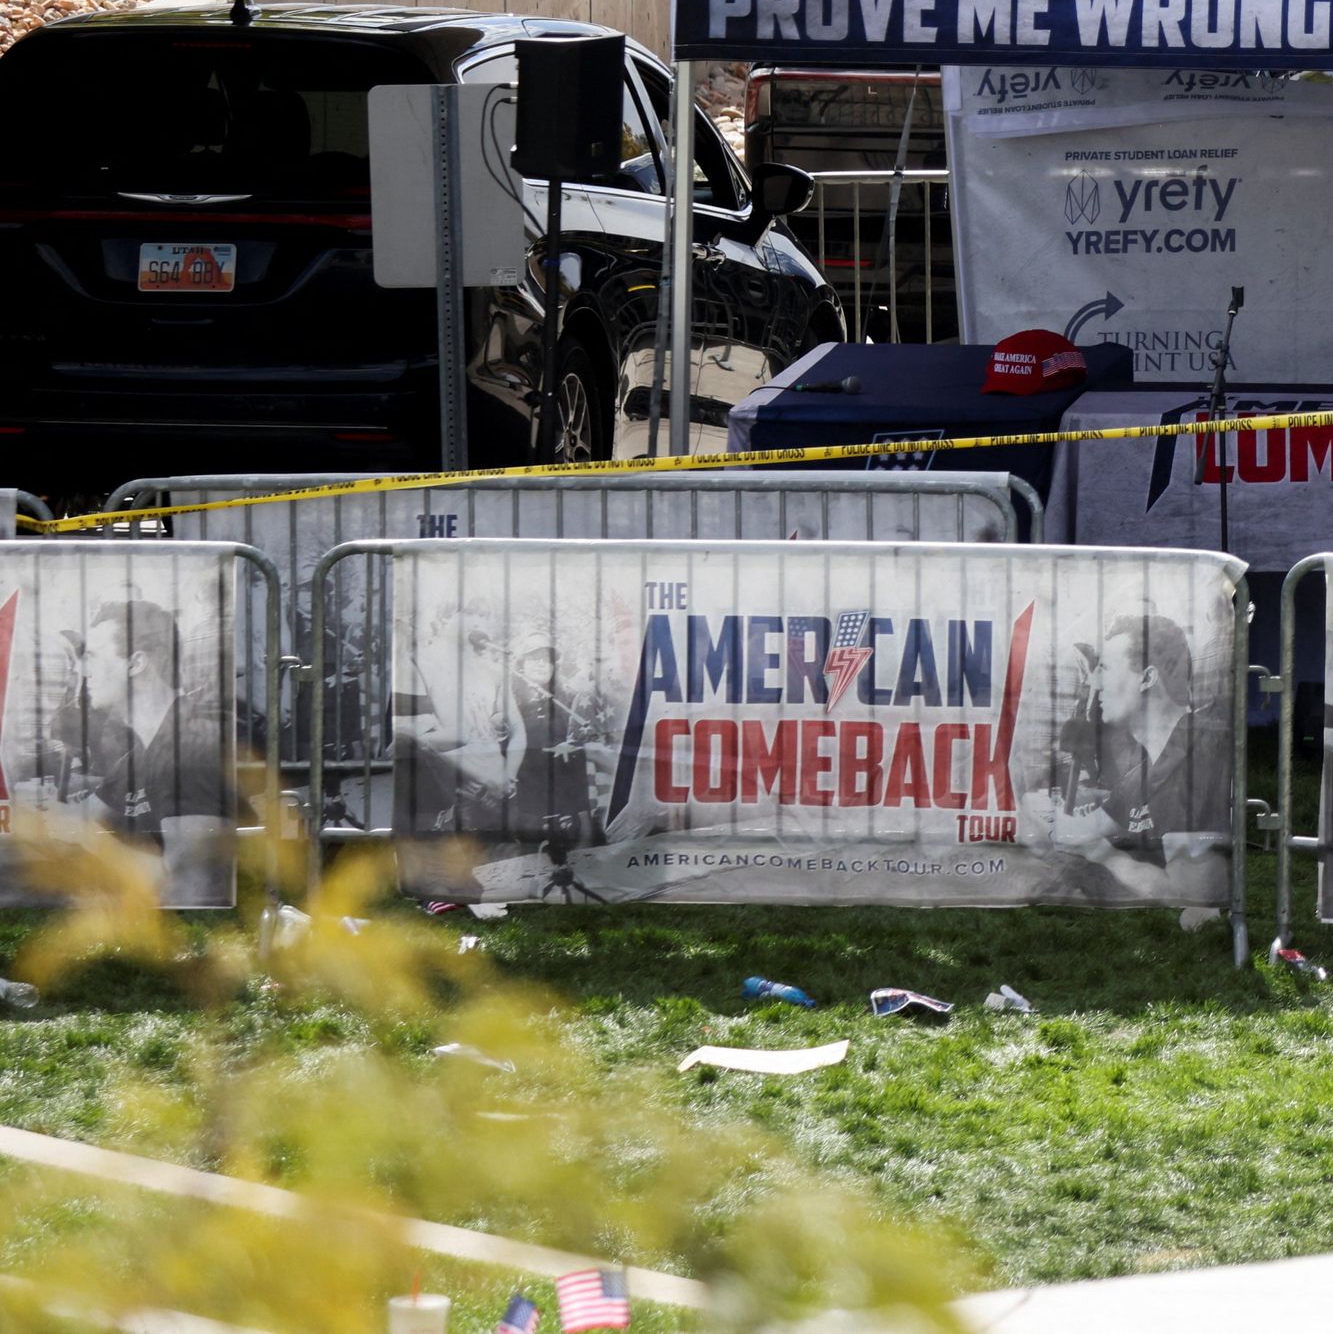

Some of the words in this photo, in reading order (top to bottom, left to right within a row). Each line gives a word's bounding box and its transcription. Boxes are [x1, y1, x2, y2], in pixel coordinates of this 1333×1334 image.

[1005, 104, 1026, 113] LOAN
[1028, 100, 1063, 111] STUDENT
[1065, 151, 1111, 161] PRIVATE
[1114, 150, 1164, 160] STUDENT
[1167, 149, 1197, 159] LOAN
[1200, 148, 1239, 158] RELIEF
[1065, 228, 1236, 254] YREFY.COM
[1097, 331, 1224, 350] TURNING
[1005, 353, 1037, 365] AMERICA
[1010, 364, 1032, 375] AGAIN
[1288, 416, 1317, 428] POLICE
[417, 514, 458, 539] THE
[645, 581, 688, 611] THE
[957, 814, 1017, 844] TOUR
[627, 853, 1006, 876] AMERICANCOMEBACKTOUR.COM
